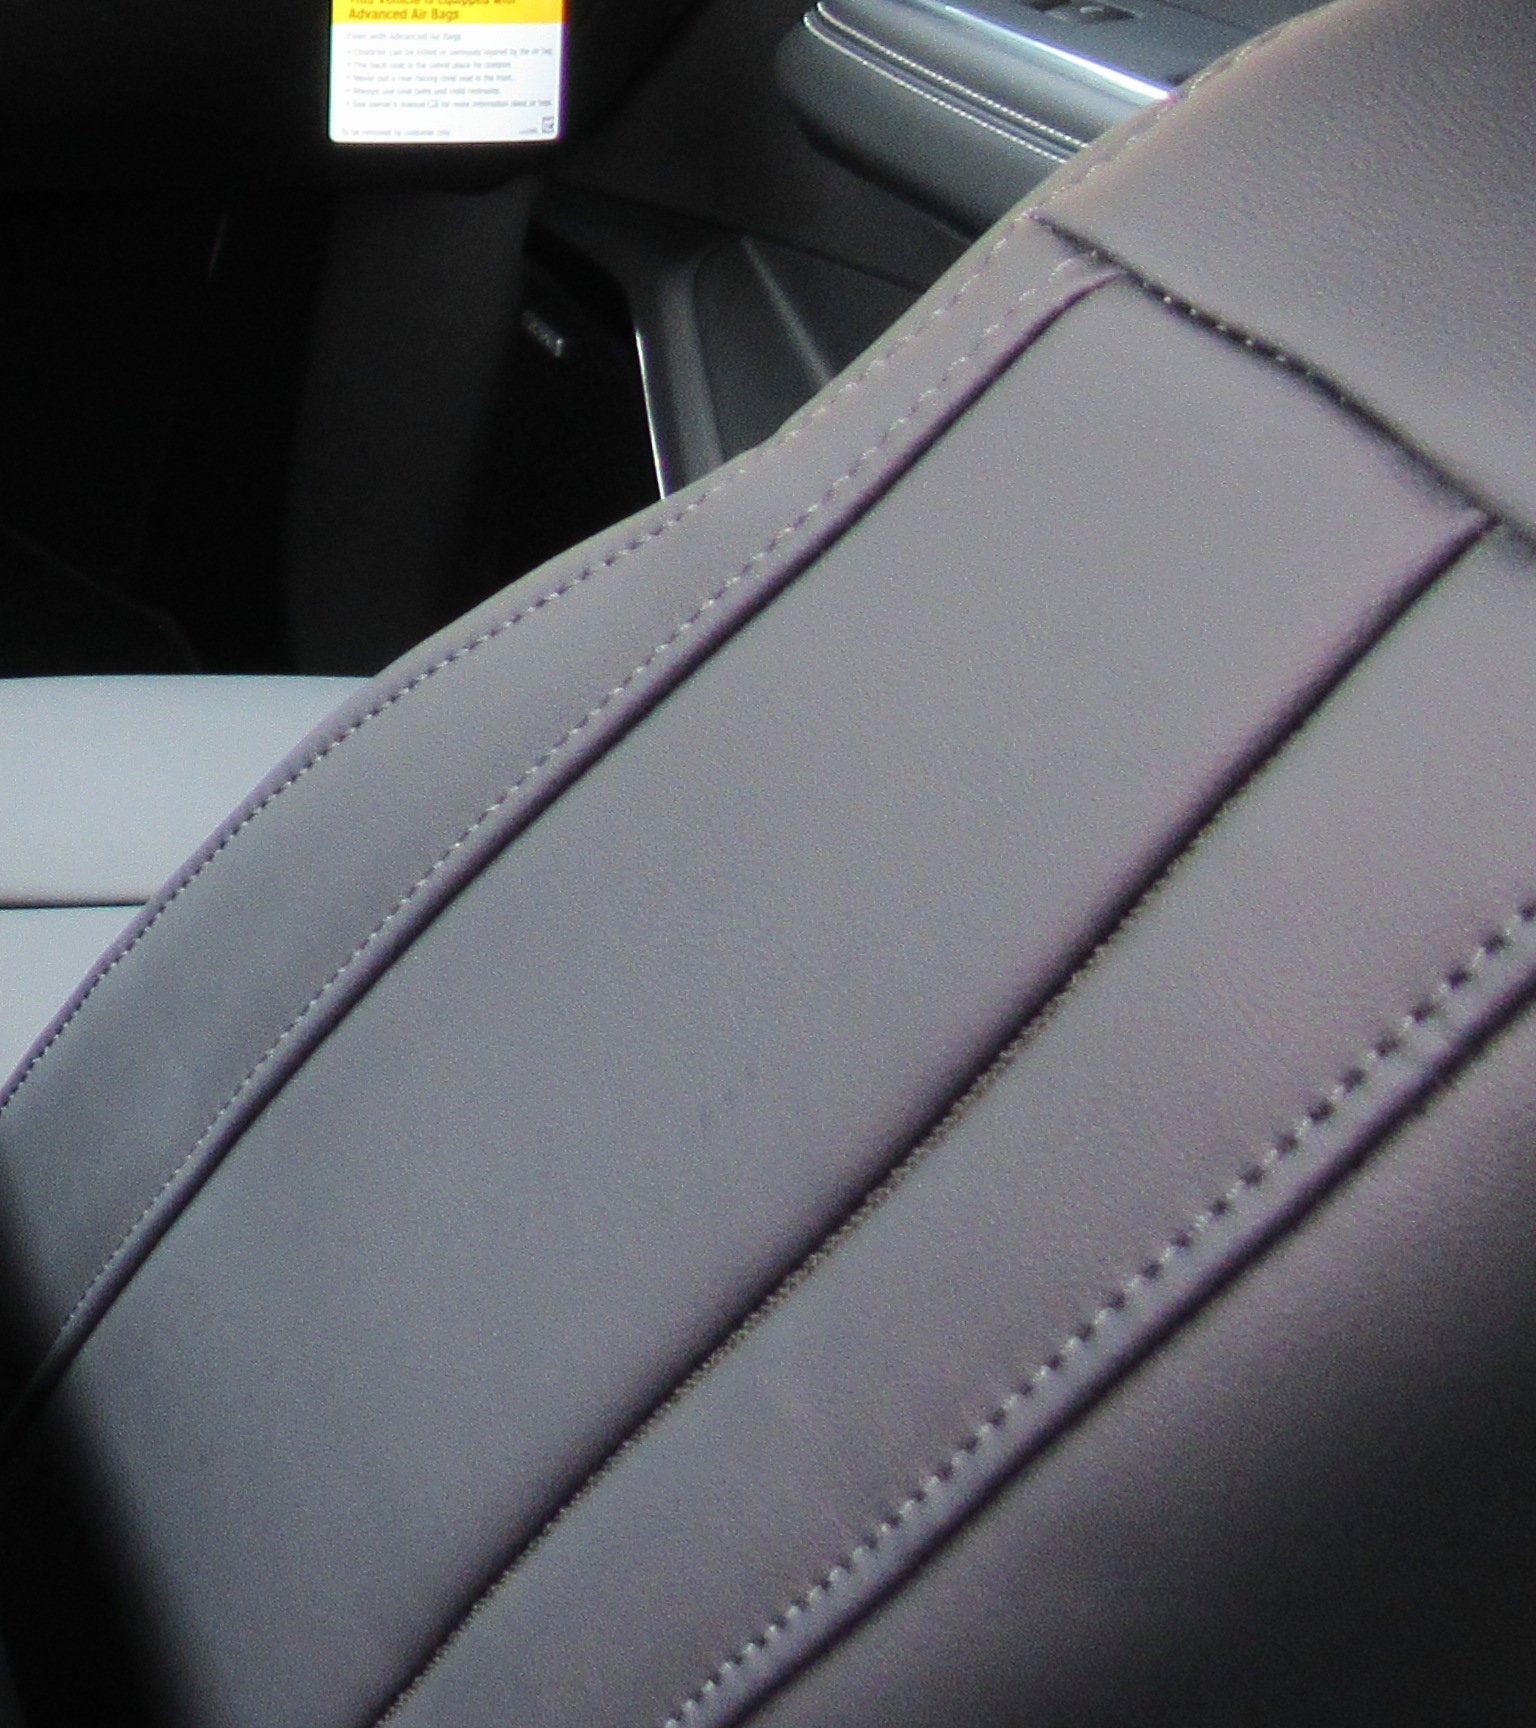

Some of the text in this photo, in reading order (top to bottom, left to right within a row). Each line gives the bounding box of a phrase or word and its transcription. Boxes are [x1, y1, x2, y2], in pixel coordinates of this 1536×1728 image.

[348, 8, 459, 22] Advanced Air Bags
